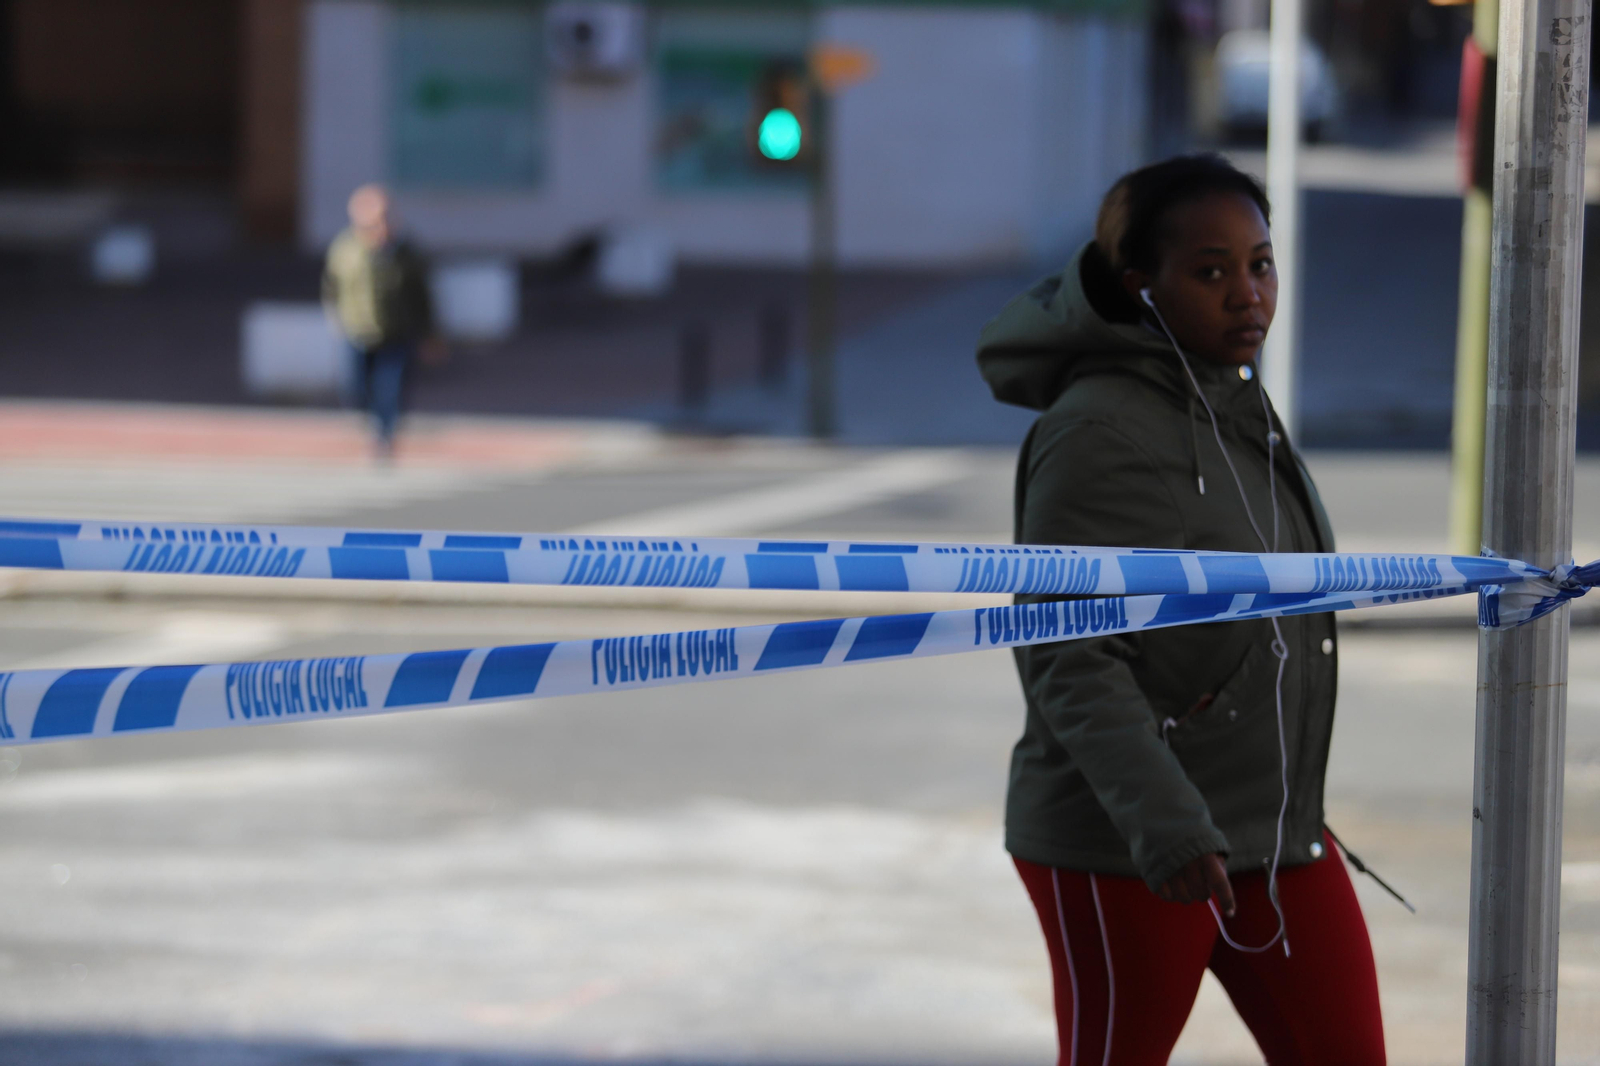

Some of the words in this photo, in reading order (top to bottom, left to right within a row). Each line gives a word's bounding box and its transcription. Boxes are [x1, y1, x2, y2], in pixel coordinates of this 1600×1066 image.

[591, 633, 672, 685] POLICIA
[676, 627, 739, 676] LOCAL
[225, 659, 305, 719] POLICIA
[307, 656, 368, 712] LOCAL
